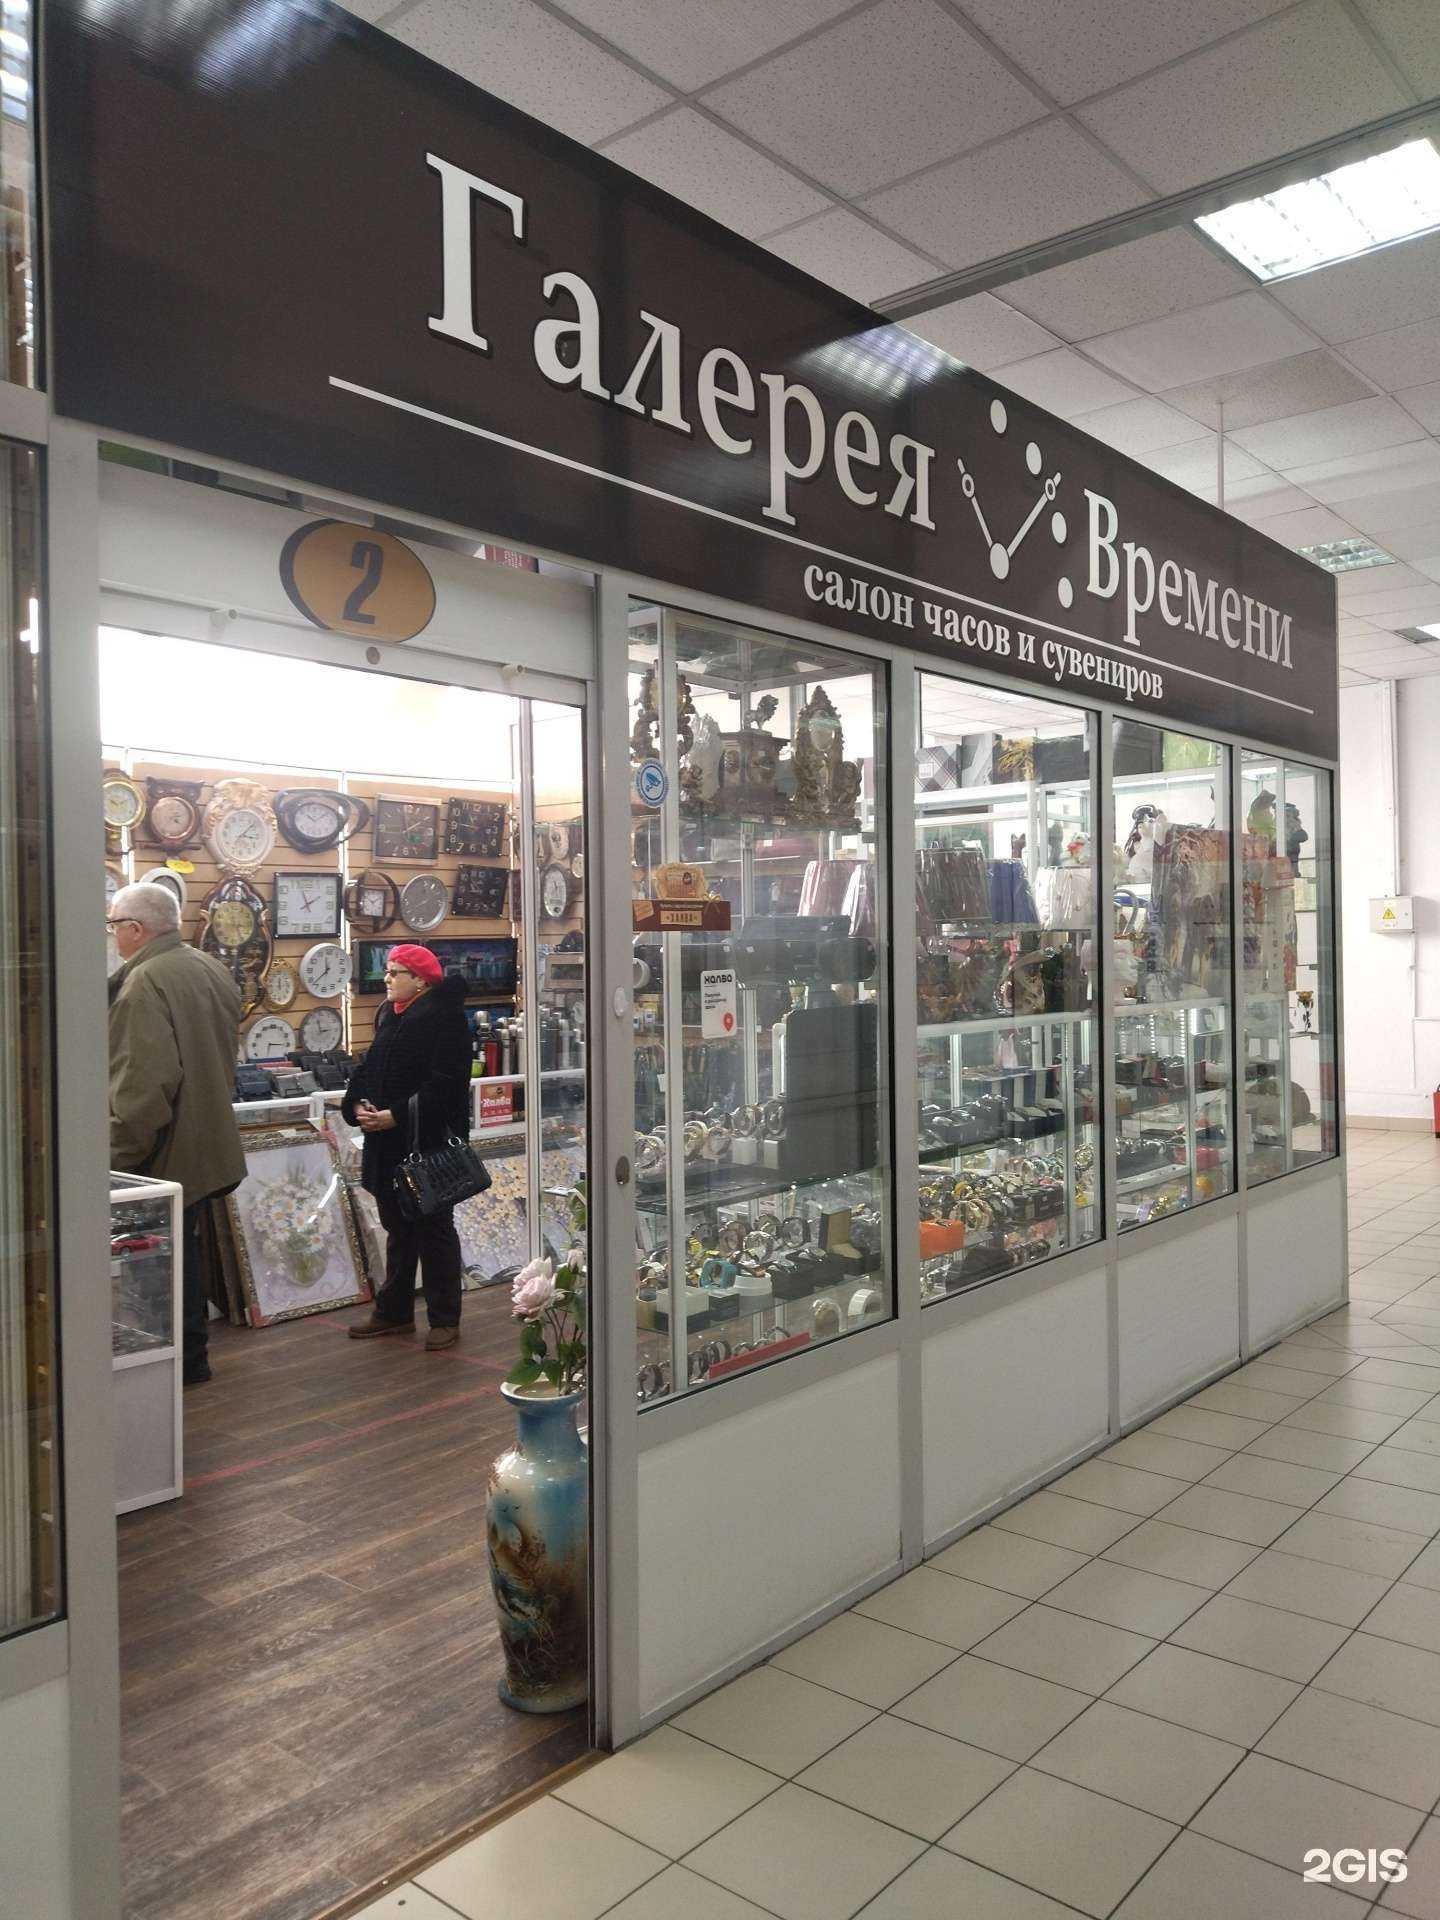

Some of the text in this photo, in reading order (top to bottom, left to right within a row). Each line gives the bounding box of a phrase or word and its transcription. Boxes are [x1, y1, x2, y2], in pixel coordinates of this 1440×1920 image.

[426, 152, 1294, 670] Галерея Времени
[342, 540, 384, 615] 2
[804, 564, 1164, 702] салон часов и сувениров
